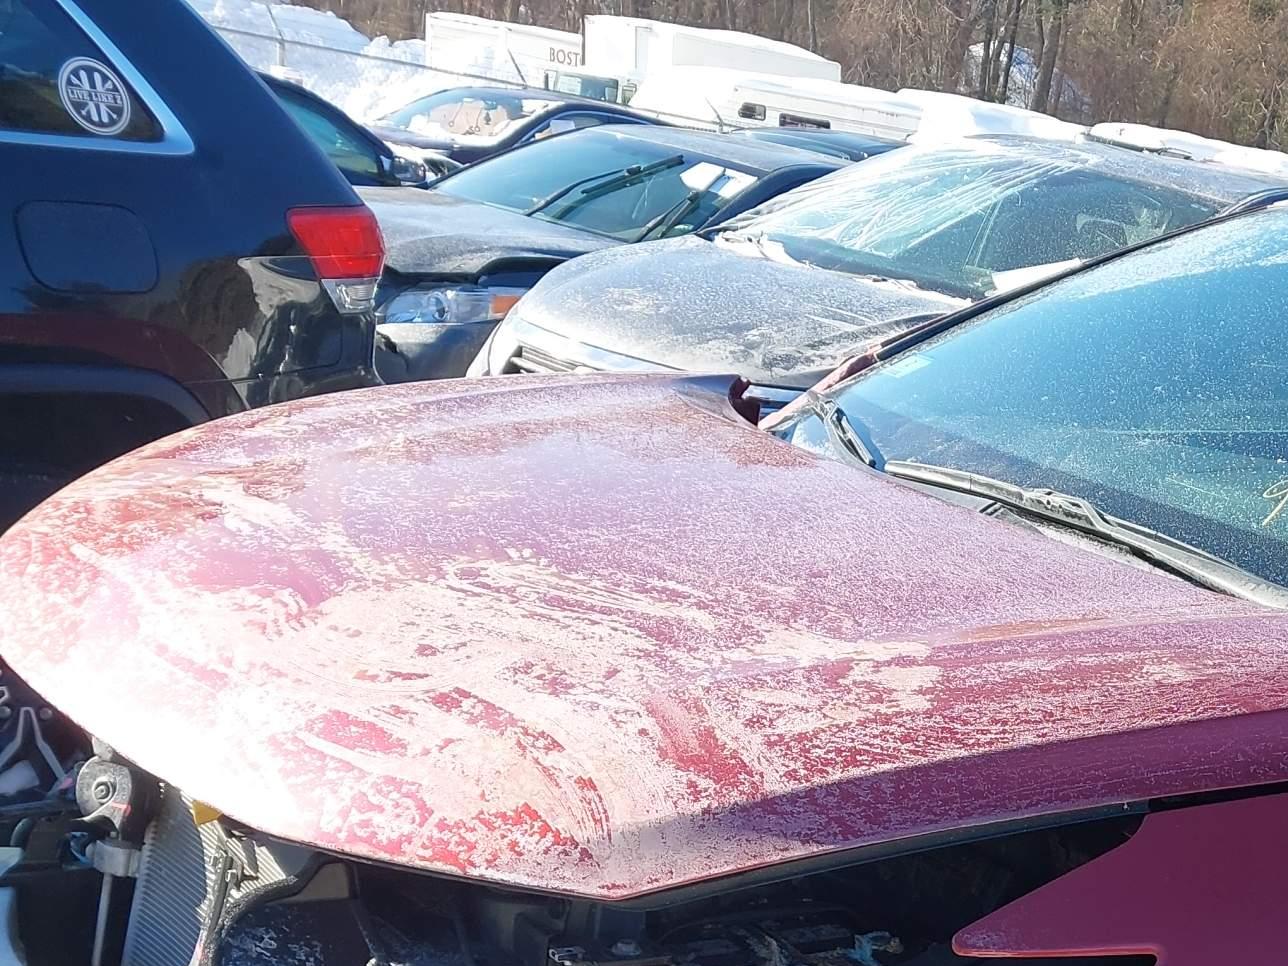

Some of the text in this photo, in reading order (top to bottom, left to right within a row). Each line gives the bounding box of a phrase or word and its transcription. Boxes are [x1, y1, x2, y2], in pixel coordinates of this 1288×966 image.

[549, 47, 582, 67] BOST
[68, 89, 89, 100] LIVE
[92, 92, 113, 103] LIKE
